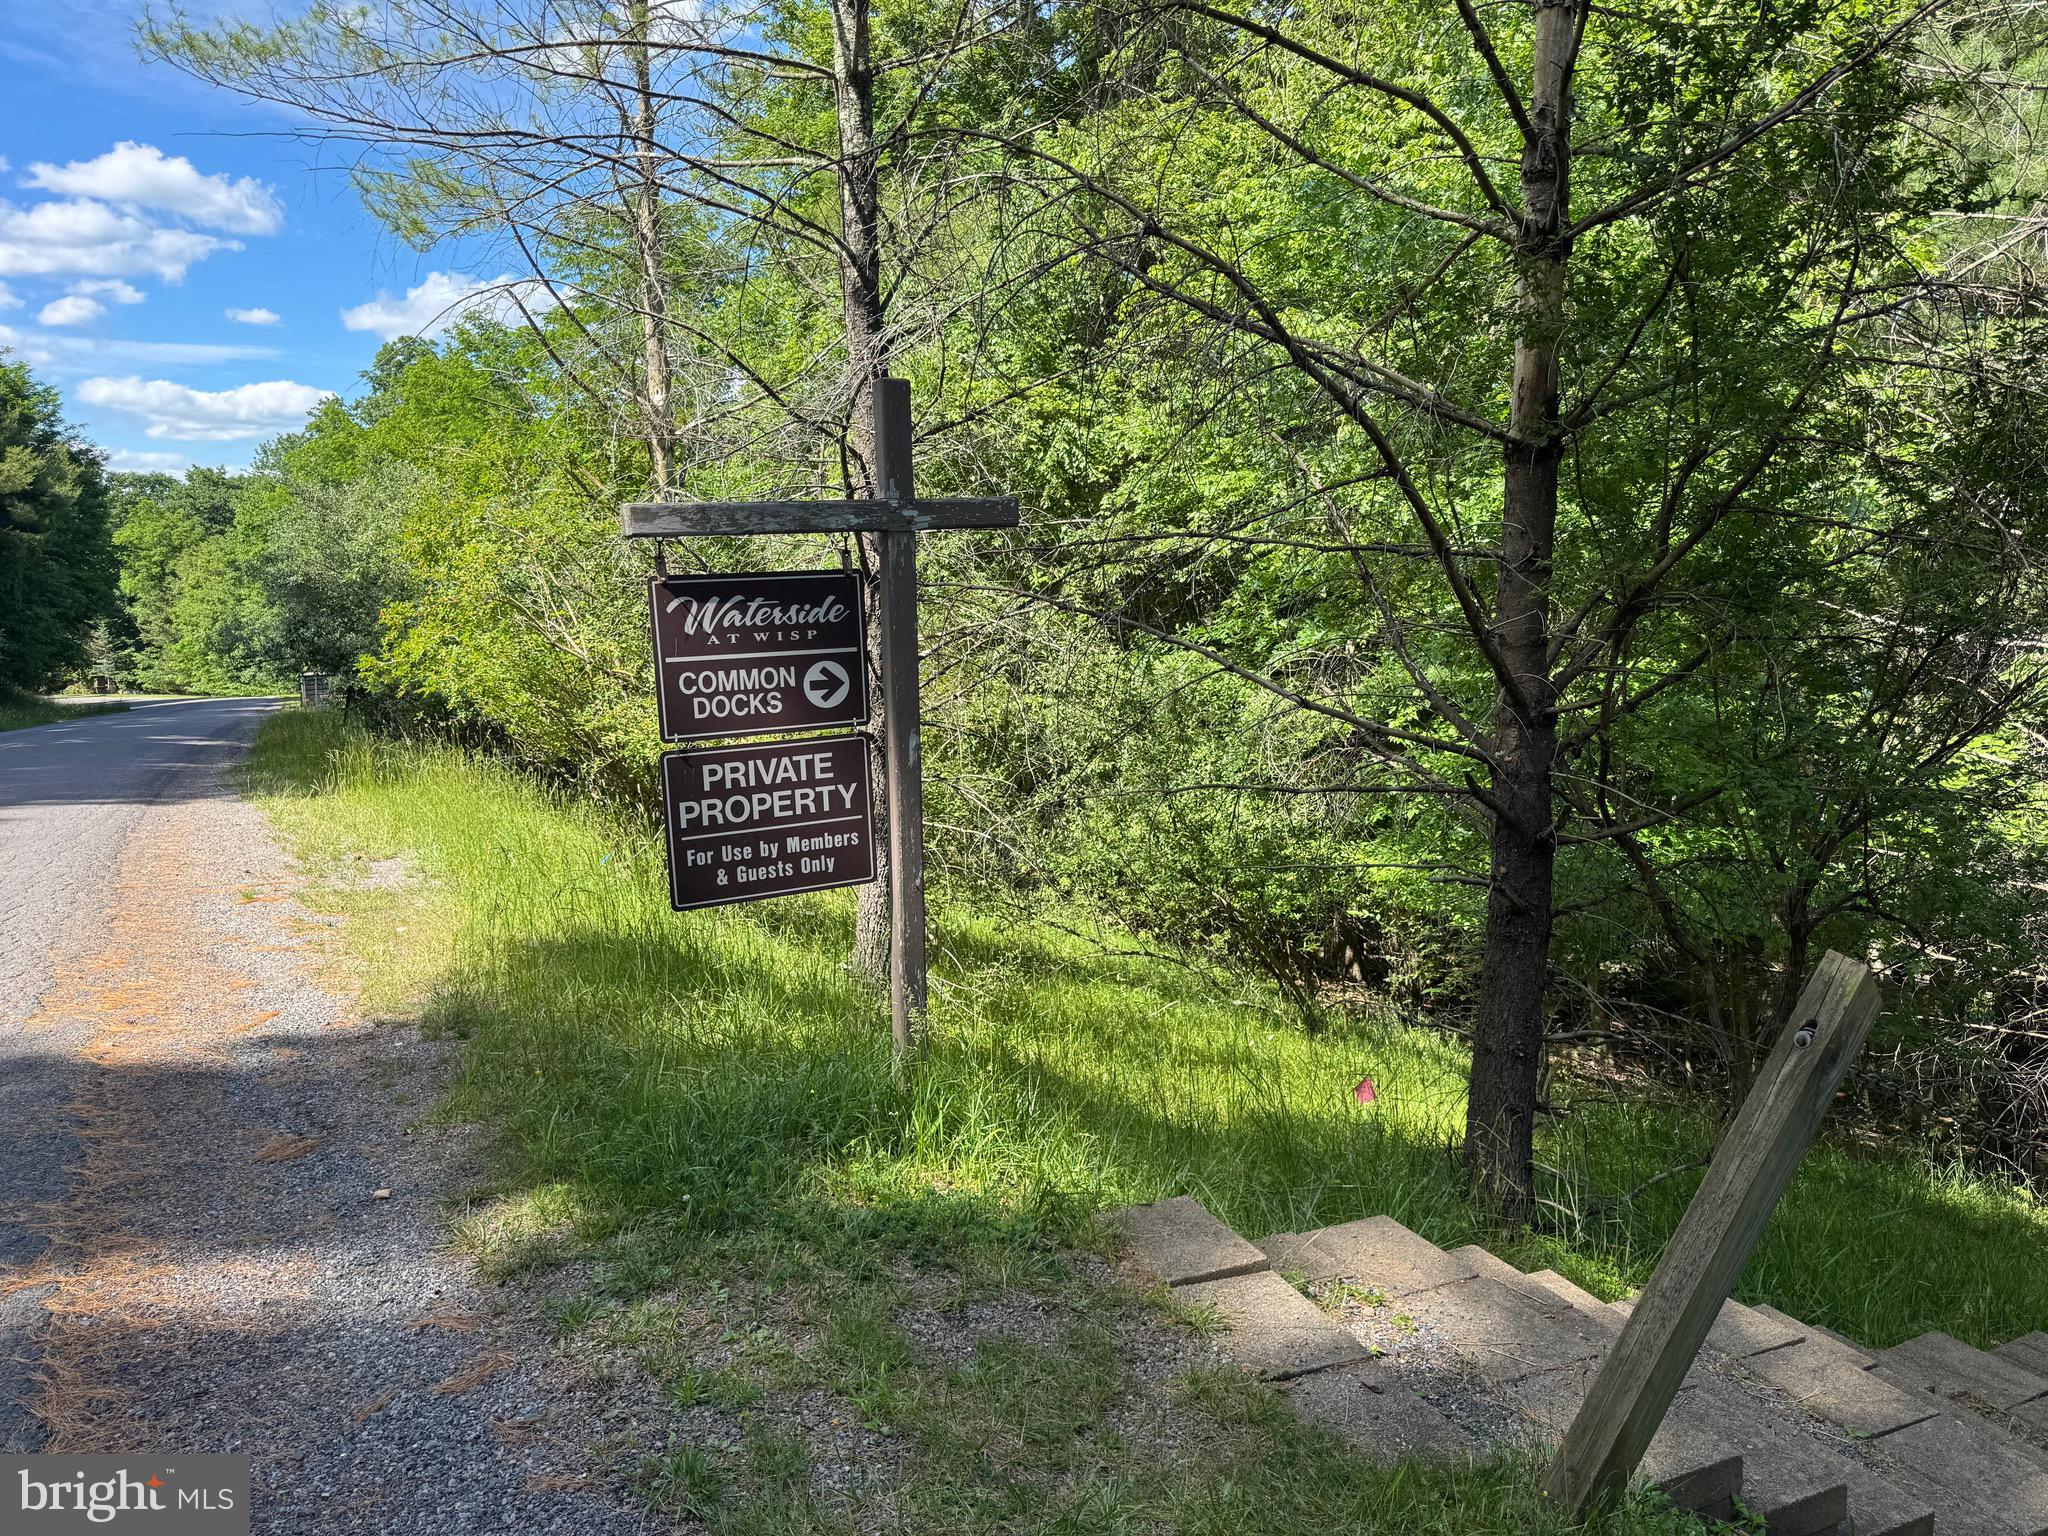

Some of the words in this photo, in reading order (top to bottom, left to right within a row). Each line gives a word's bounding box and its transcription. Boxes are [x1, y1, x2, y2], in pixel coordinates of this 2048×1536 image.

[666, 595, 850, 635] Waterside
[707, 633, 740, 645] AT
[753, 630, 818, 643] WISP
[678, 666, 796, 695] COMMON
[693, 691, 783, 719] DOCKS
[702, 752, 834, 791] PRIVATE
[679, 782, 858, 829] PROPERTY
[686, 849, 714, 867] For
[721, 845, 753, 863] Use
[760, 841, 779, 859] by
[786, 832, 859, 854] Members
[716, 869, 729, 885] &
[736, 860, 794, 883] Guests
[801, 855, 835, 874] Only
